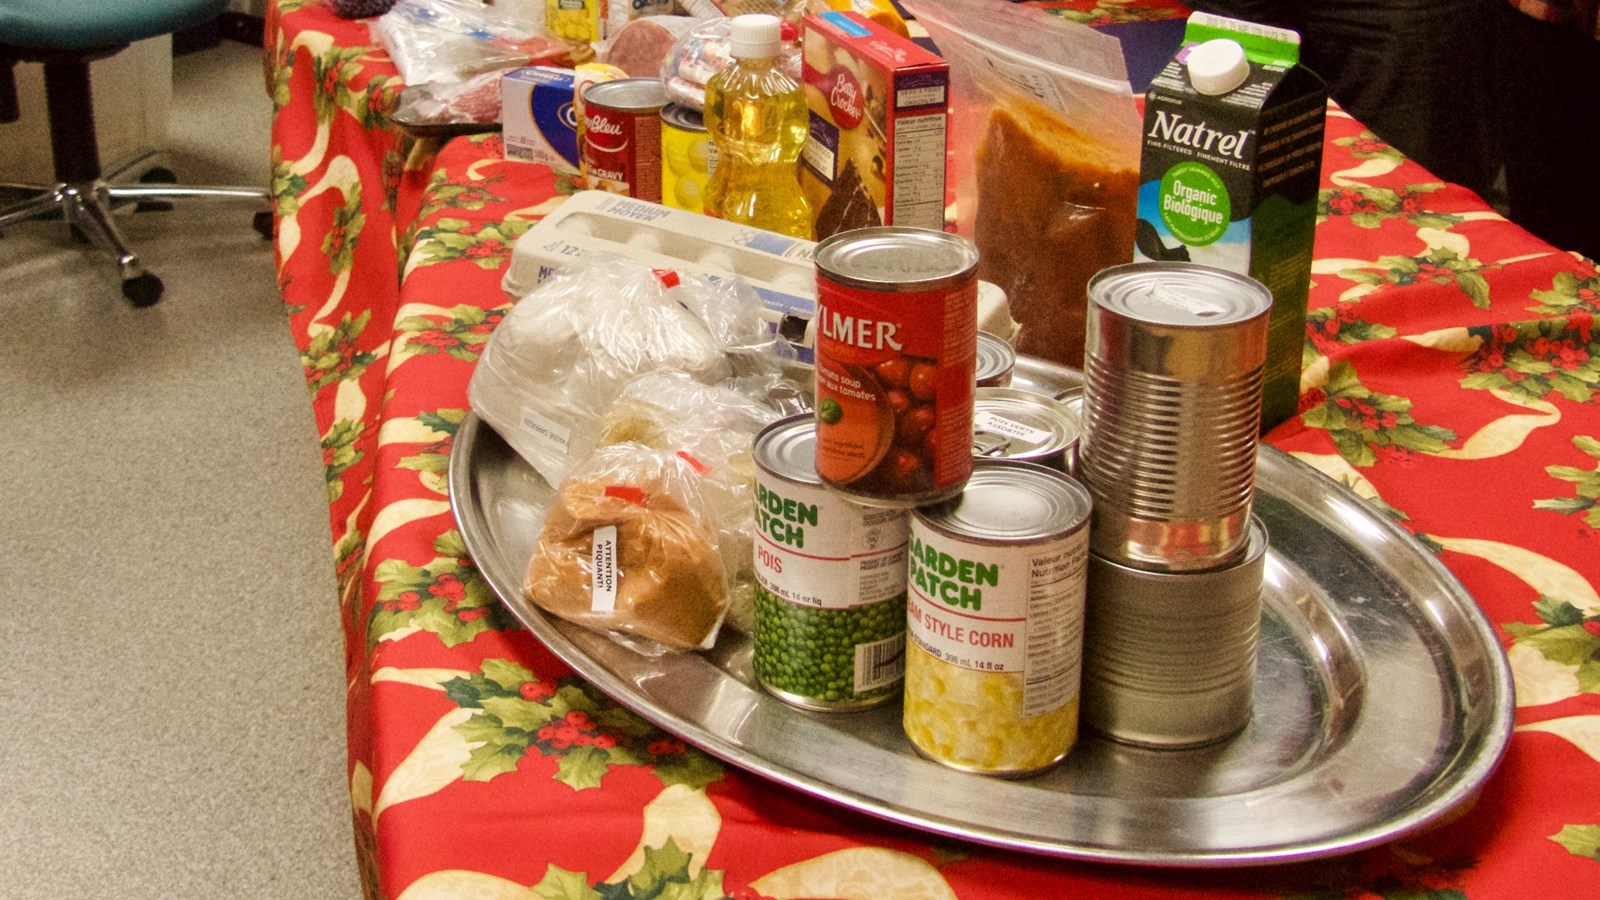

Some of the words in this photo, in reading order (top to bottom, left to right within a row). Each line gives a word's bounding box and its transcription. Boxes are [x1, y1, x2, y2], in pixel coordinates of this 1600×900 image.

[831, 86, 860, 119] Crocker
[837, 74, 857, 104] Betty
[1148, 110, 1248, 158] Natrel
[598, 168, 624, 180] GRAVY
[1173, 180, 1217, 206] Organic
[607, 206, 656, 221] MOYEN
[616, 200, 672, 218] MEDIUM
[1164, 194, 1223, 225] Biologique
[840, 386, 876, 401] tomates
[841, 376, 860, 388] soup
[758, 545, 782, 574] POIS
[910, 527, 998, 587] GARDEN
[1032, 554, 1061, 567] Valeur
[1032, 561, 1070, 578] Nutrition
[910, 556, 982, 611] PATCH
[909, 598, 921, 623] AM
[925, 614, 963, 643] STYLE
[969, 630, 1014, 648] CORN
[914, 634, 942, 658] STANDARD
[945, 653, 958, 664] 398
[960, 656, 972, 667] mL
[975, 661, 984, 669] 14
[986, 661, 992, 670] fl
